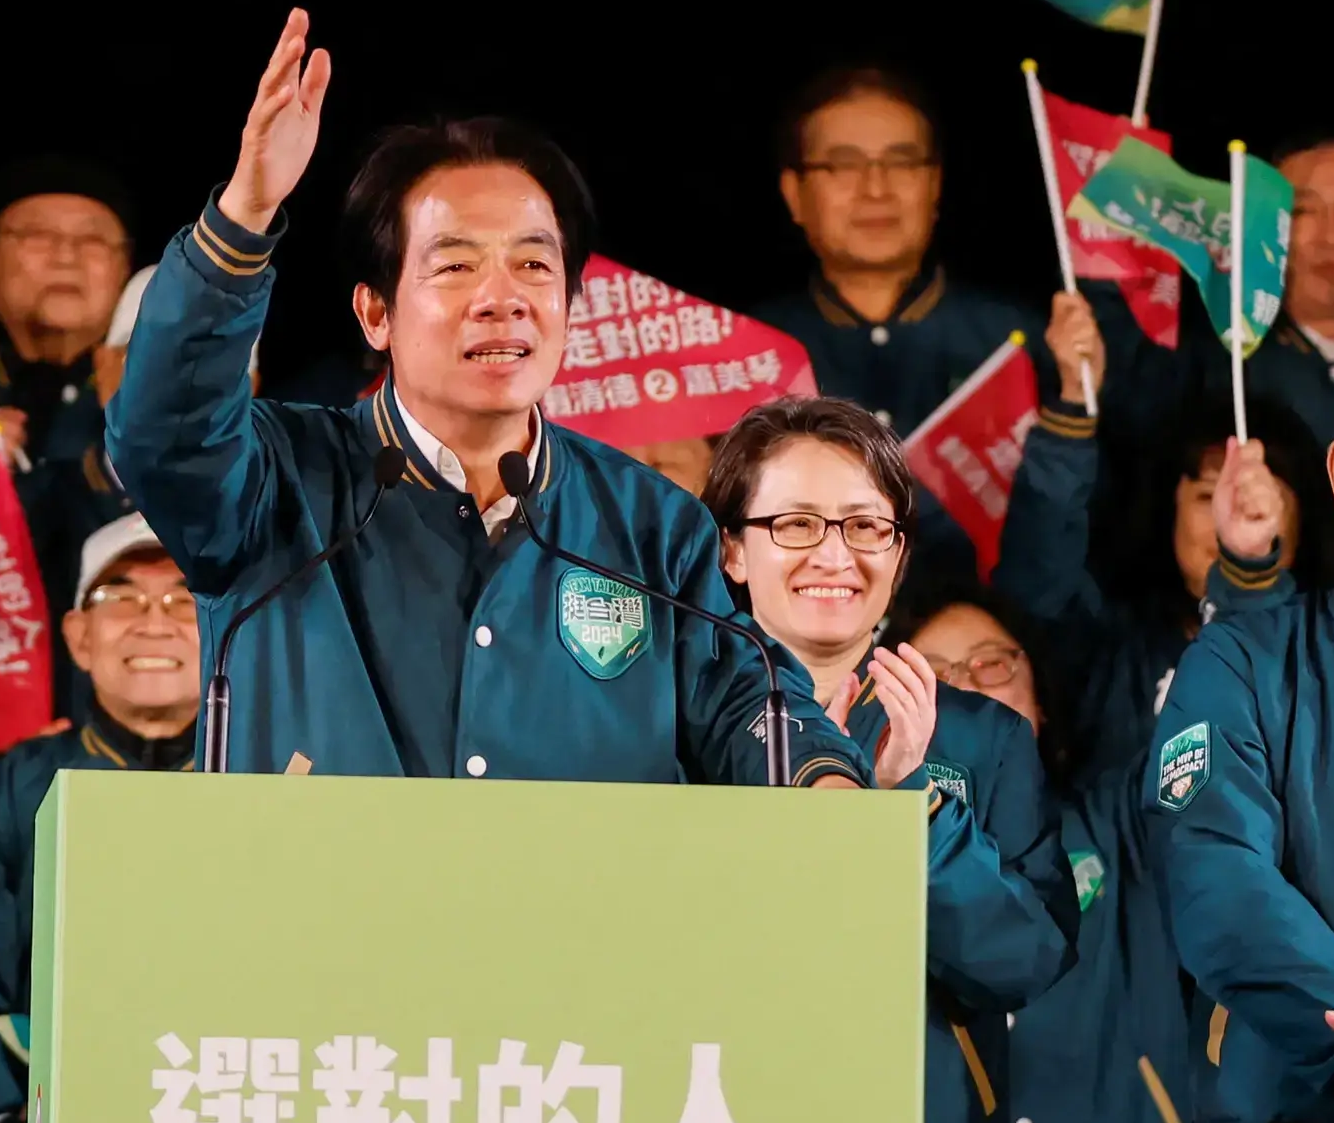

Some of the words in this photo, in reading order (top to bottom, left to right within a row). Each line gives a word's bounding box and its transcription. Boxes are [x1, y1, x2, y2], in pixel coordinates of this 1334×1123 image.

[563, 305, 733, 371] 走對的路!
[562, 590, 644, 630] 挺台灣
[581, 623, 624, 645] 2024
[1176, 750, 1194, 767] MVP
[1194, 747, 1205, 759] OF
[1161, 758, 1205, 788] DEMOCRACY
